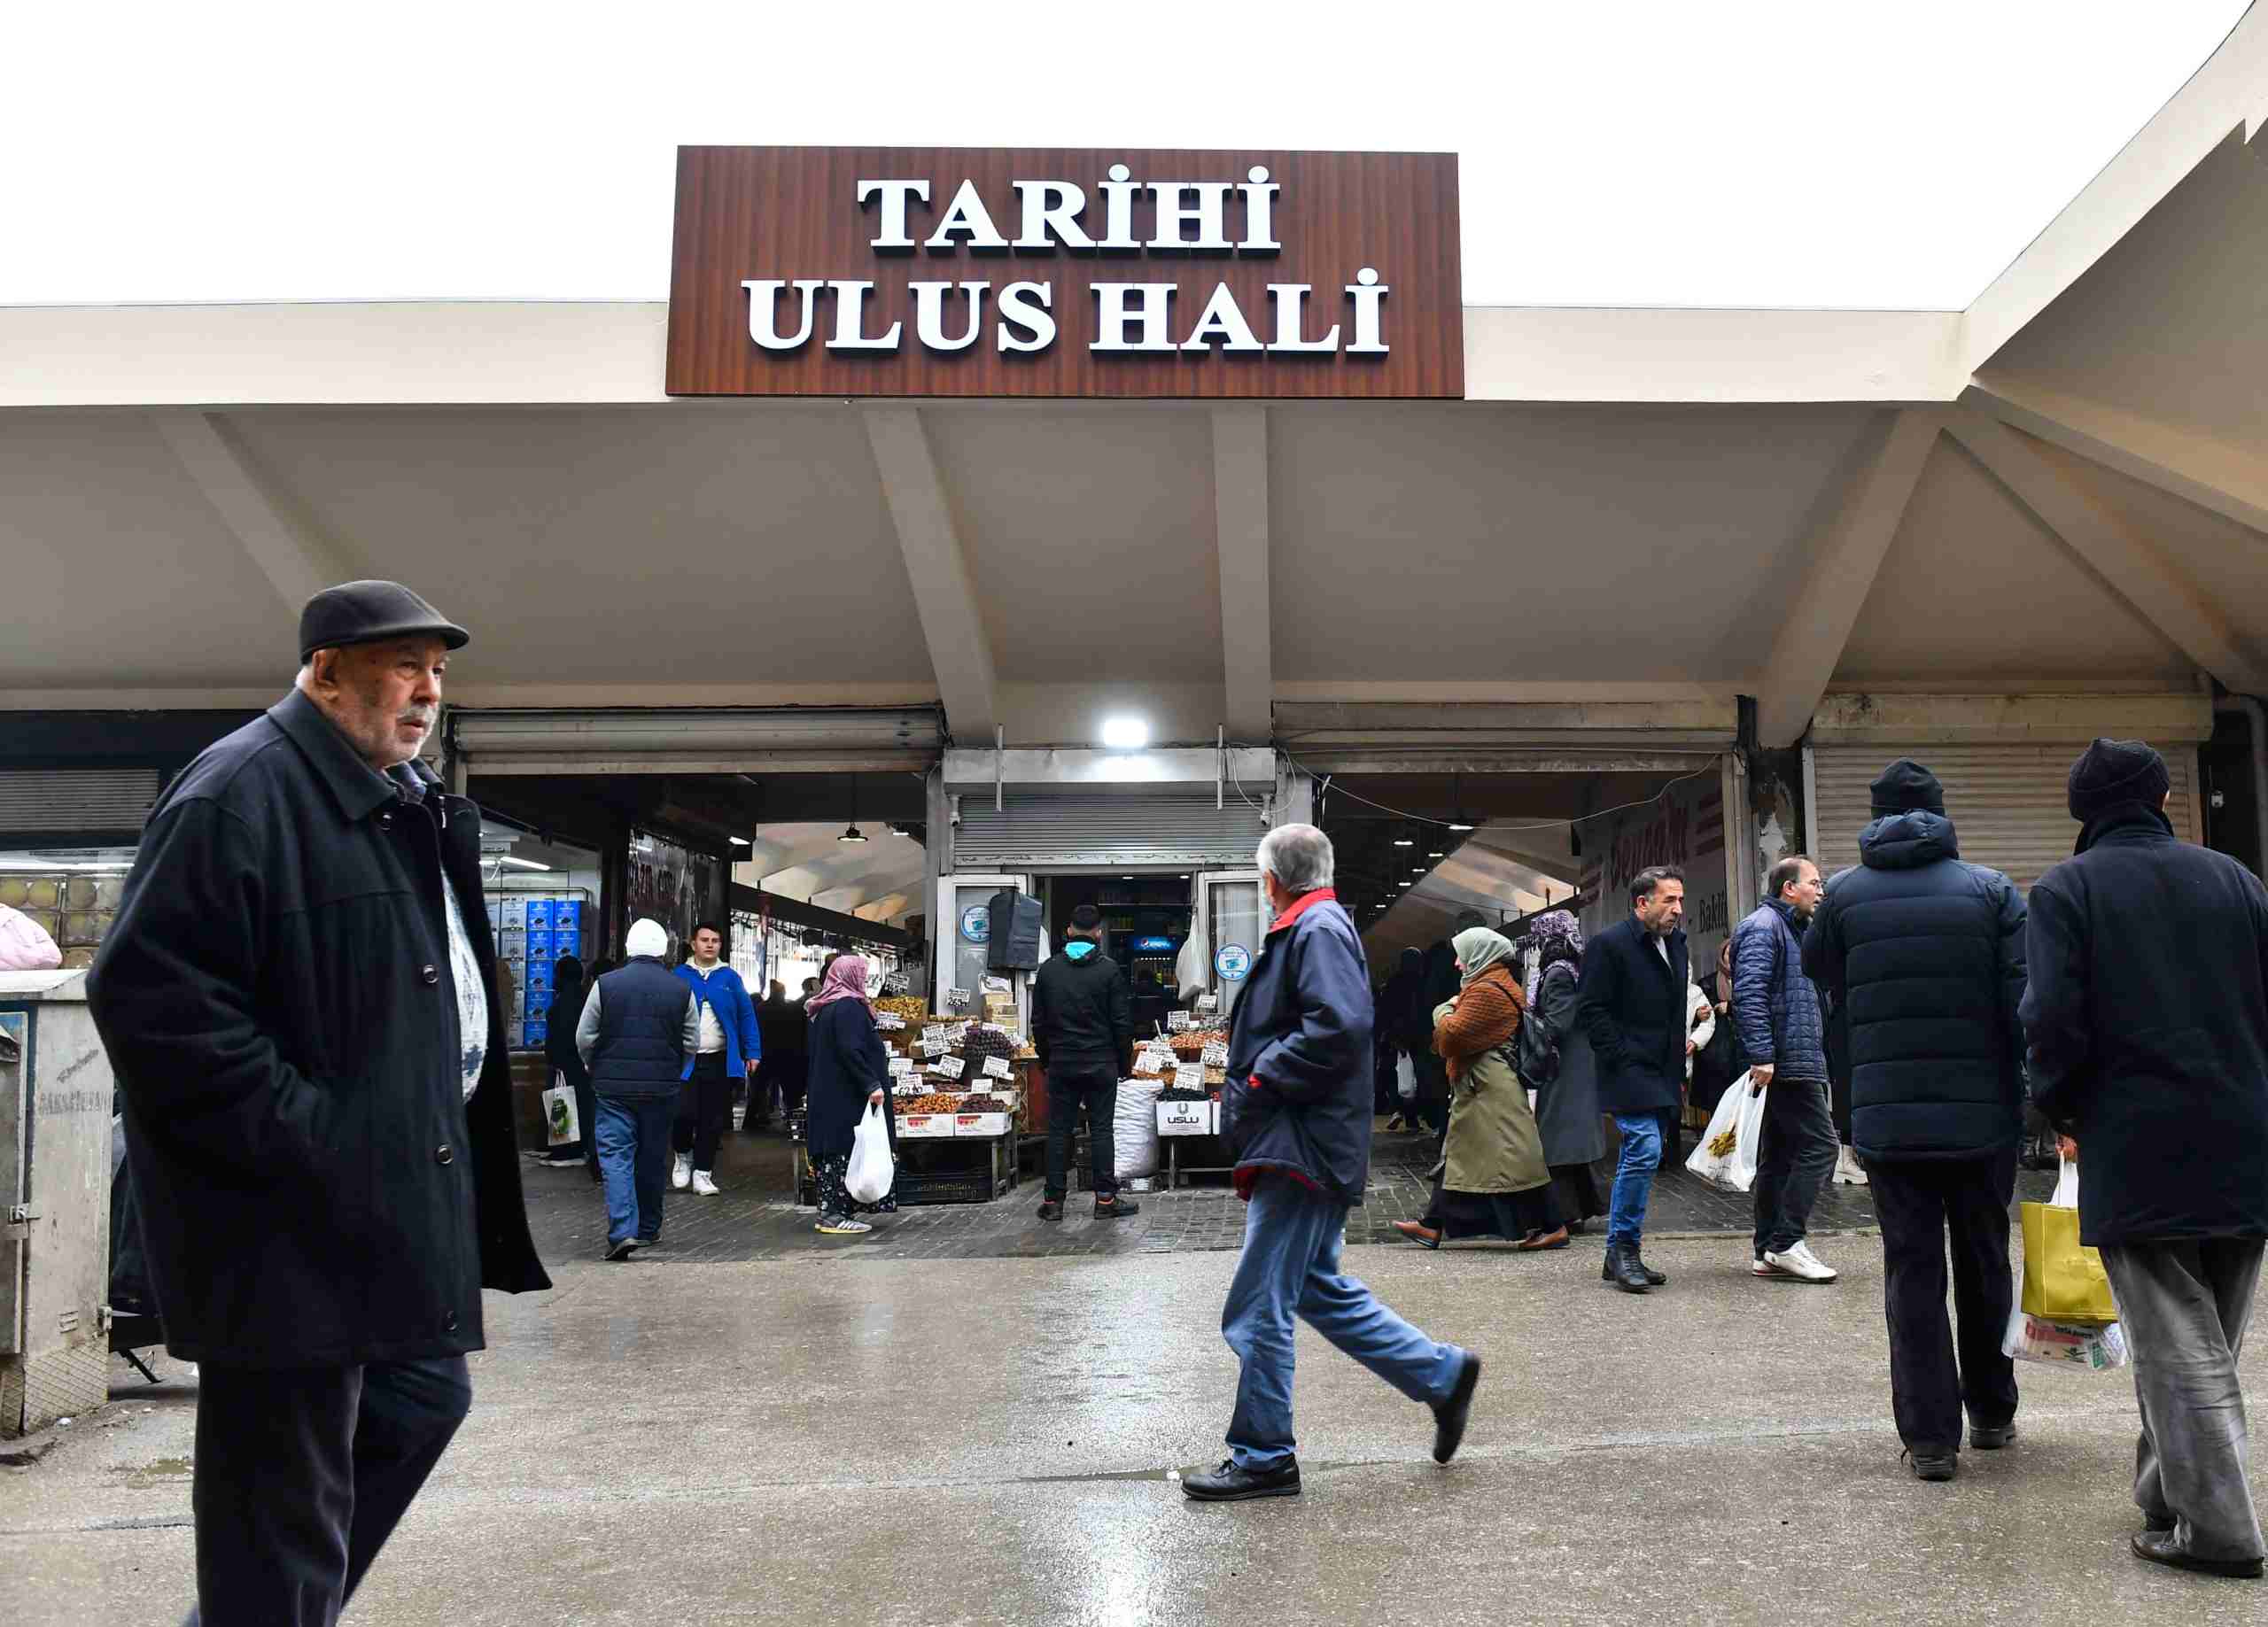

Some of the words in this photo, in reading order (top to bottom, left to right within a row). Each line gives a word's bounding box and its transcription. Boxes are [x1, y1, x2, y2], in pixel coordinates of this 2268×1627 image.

[858, 165, 1281, 248] TARİHİ
[742, 281, 1056, 351] ULUS
[1090, 268, 1390, 352] HALİ
